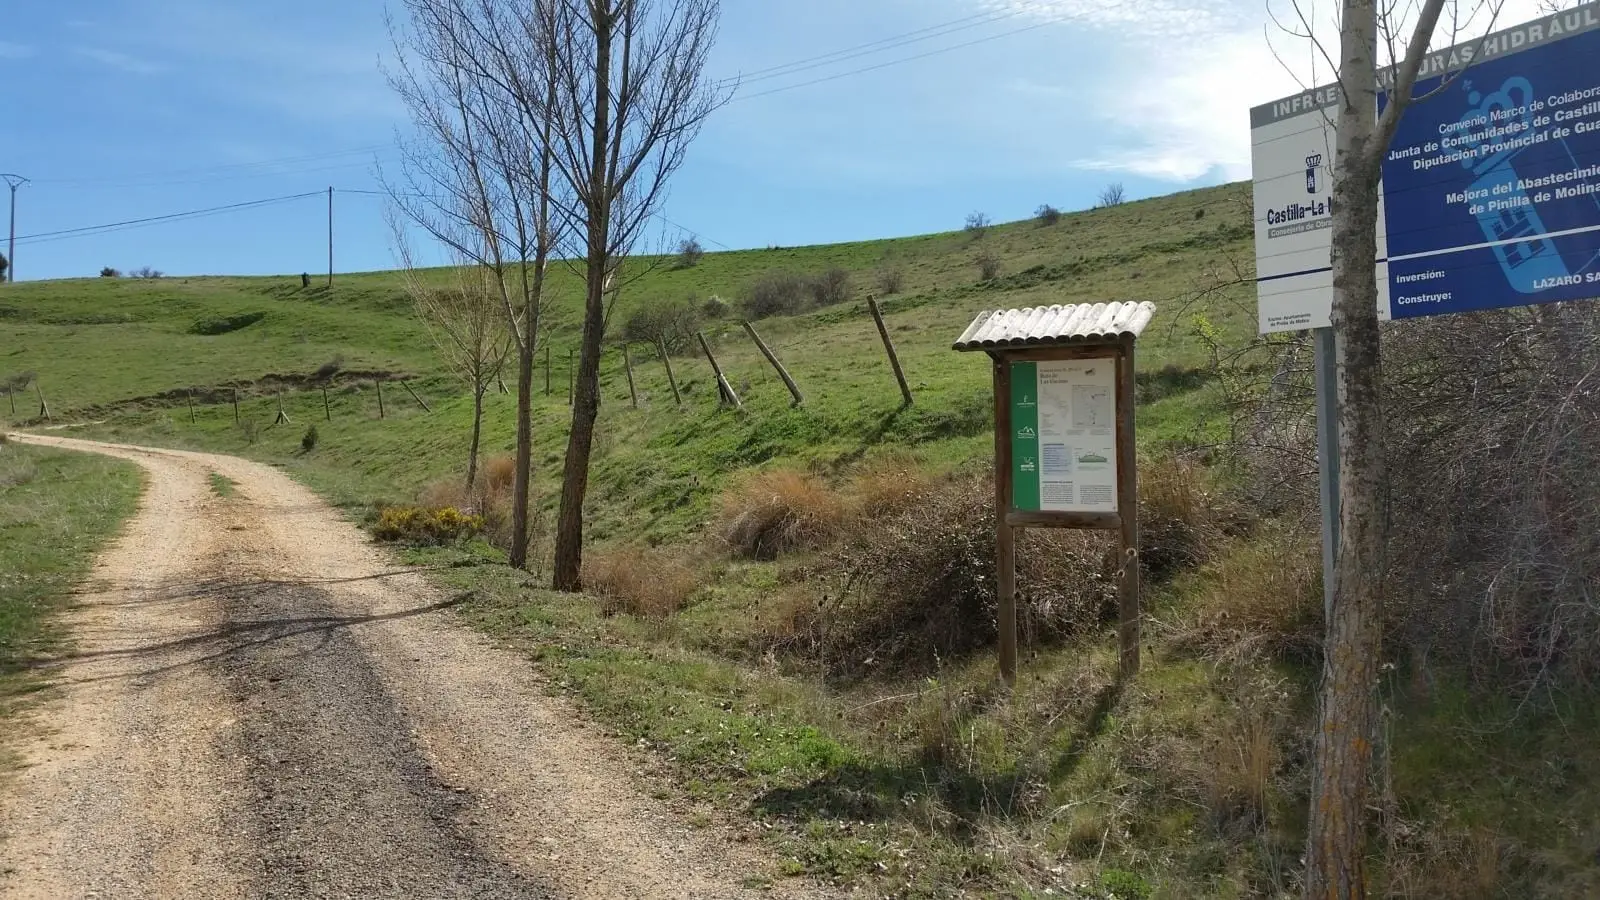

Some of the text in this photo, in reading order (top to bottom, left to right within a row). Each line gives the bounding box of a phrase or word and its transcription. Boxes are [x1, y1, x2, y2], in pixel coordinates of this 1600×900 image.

[1438, 114, 1488, 134] Convenio
[1490, 105, 1526, 122] Marco
[1529, 99, 1545, 112] de
[1388, 145, 1421, 161] Junta
[1424, 142, 1439, 154] de
[1441, 119, 1529, 148] Comunidades
[1533, 115, 1550, 127] de
[1413, 147, 1478, 170] Diputación
[1481, 131, 1549, 156] Provincial
[1552, 127, 1570, 139] de
[1446, 187, 1489, 205] Mejora
[1492, 179, 1513, 195] del
[1469, 183, 1600, 215] de Pinilla de Molina
[1396, 269, 1445, 284] Inversión:
[1397, 291, 1452, 306] Construye:
[1533, 274, 1582, 289] LAZARO
